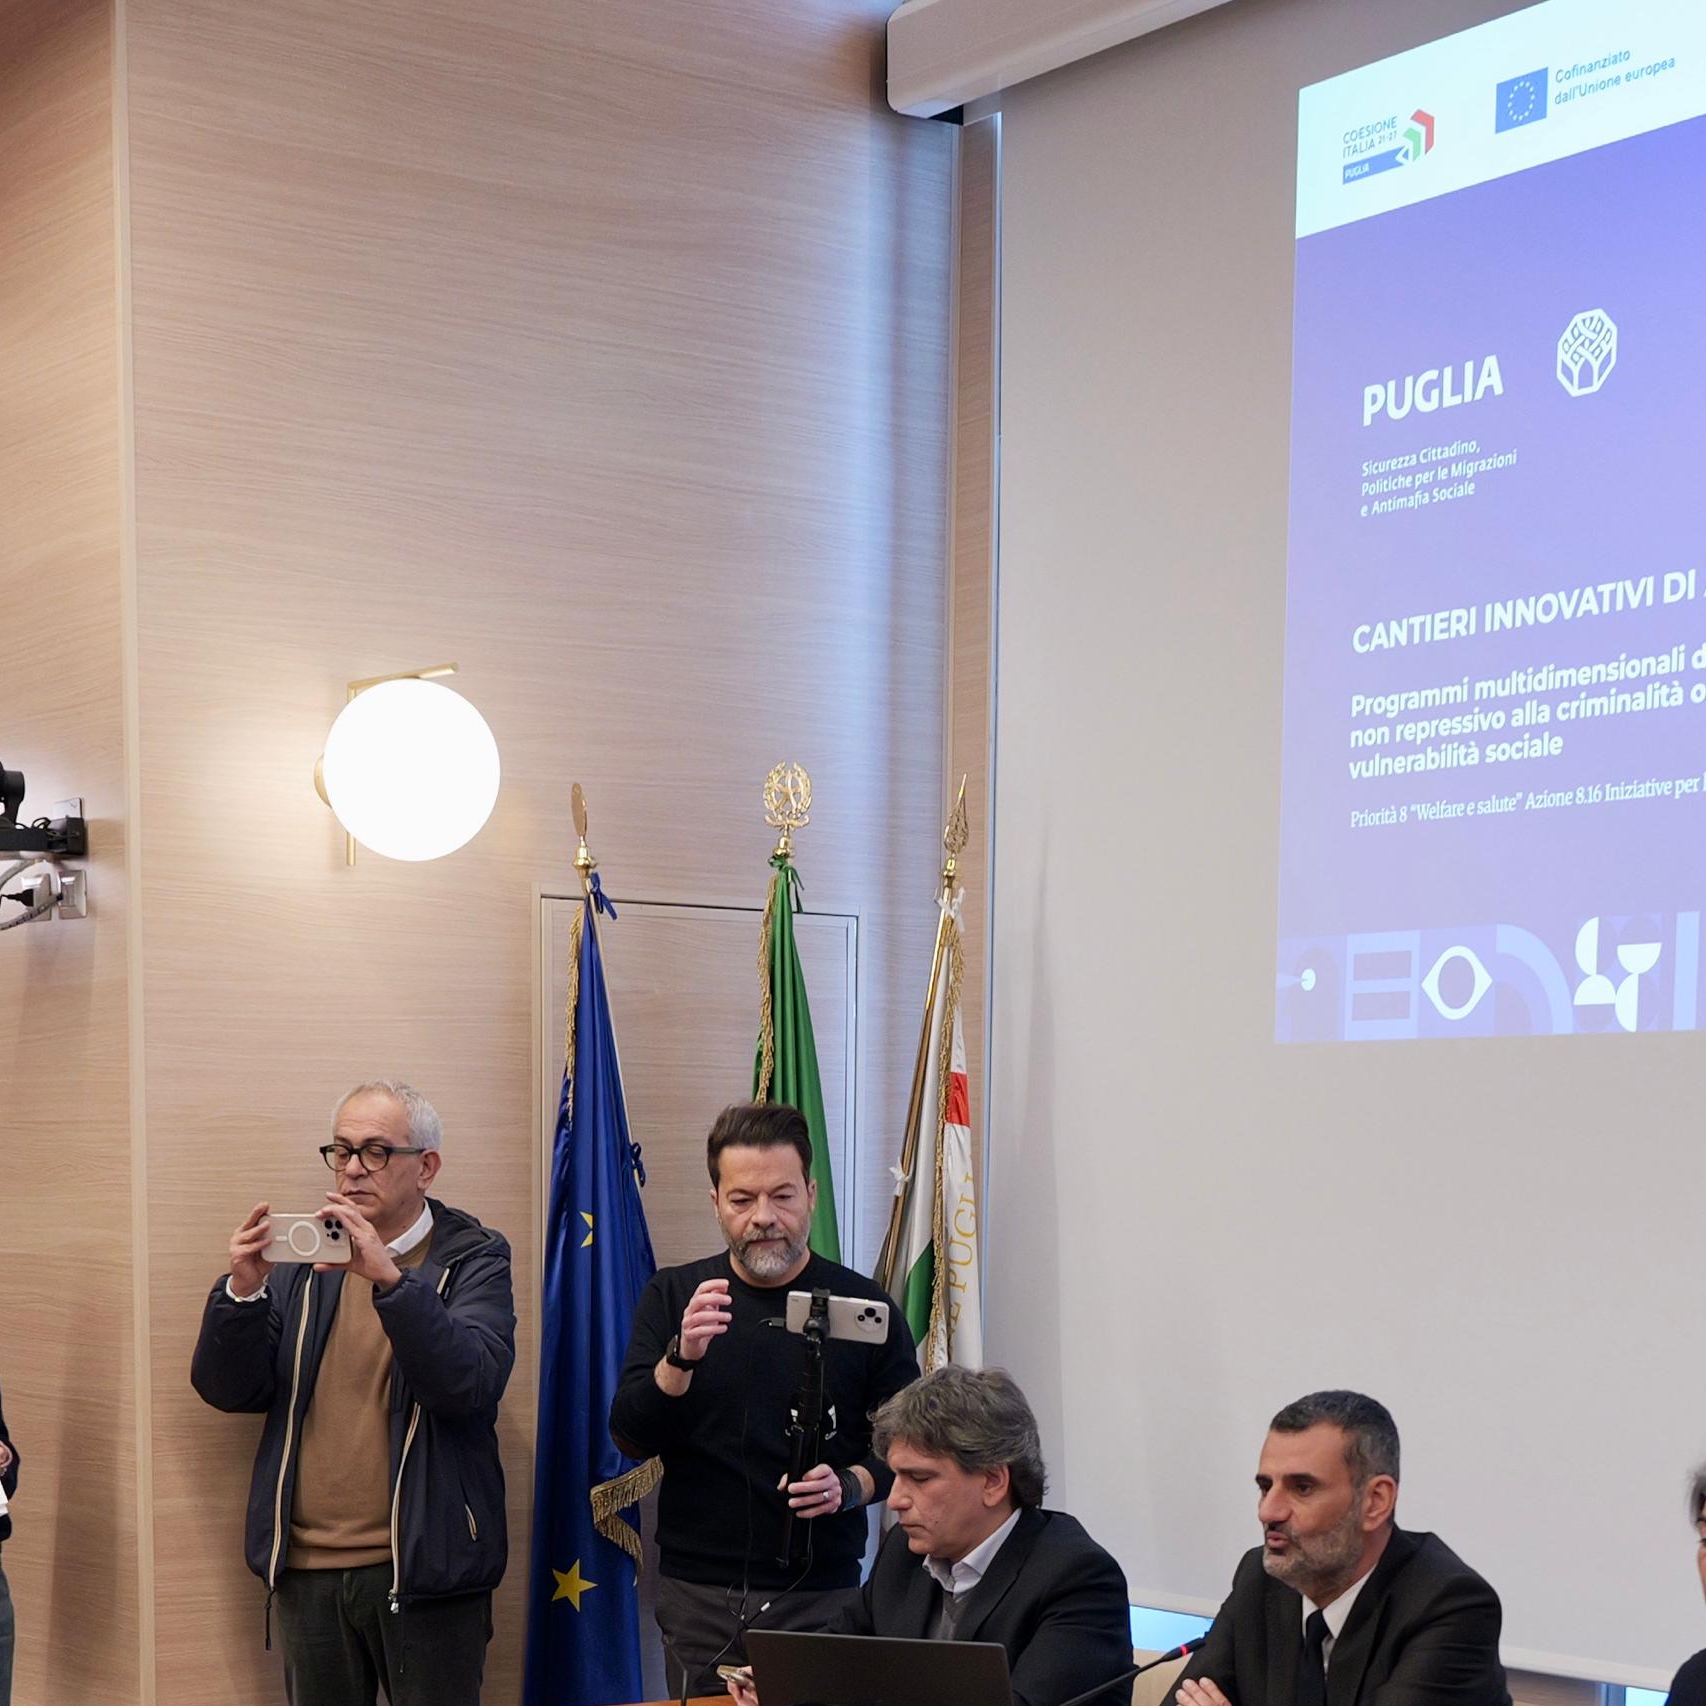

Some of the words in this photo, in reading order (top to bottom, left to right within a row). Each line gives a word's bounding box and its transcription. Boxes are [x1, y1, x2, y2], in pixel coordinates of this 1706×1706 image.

[1555, 50, 1631, 83] Cofinanziato
[1625, 58, 1675, 82] europea
[1342, 115, 1398, 144] COESIONE
[1342, 138, 1375, 159] ITALIA
[1363, 355, 1504, 427] PUGLIA
[1362, 454, 1417, 475] Sicurezza
[1419, 440, 1480, 463] Cittadino,
[1362, 474, 1412, 496] Politiche
[1415, 470, 1435, 489] per
[1438, 466, 1448, 480] le
[1451, 449, 1517, 478] Migrazioni
[1361, 505, 1368, 517] e
[1371, 490, 1429, 515] Antimafia
[1433, 481, 1475, 503] Sociale
[1353, 606, 1476, 653] CANTIERI
[1485, 576, 1654, 633] INNOVATIVI
[1663, 569, 1696, 604] DI
[1352, 676, 1469, 718] Programmi
[1475, 644, 1685, 701] multidimensionali
[1351, 726, 1389, 748] non
[1396, 706, 1505, 745] repressivo
[1511, 699, 1550, 727] alla
[1556, 680, 1684, 721] criminalità
[1349, 741, 1479, 779] vulnerabilità
[1485, 731, 1563, 763] sociale
[1351, 805, 1396, 828] Priorità
[1399, 806, 1407, 822] 8
[1467, 802, 1475, 816] e
[1525, 790, 1573, 810] Azione
[1576, 784, 1602, 804] 8.16
[1605, 778, 1672, 801] Iniziative
[1675, 778, 1700, 799] per
